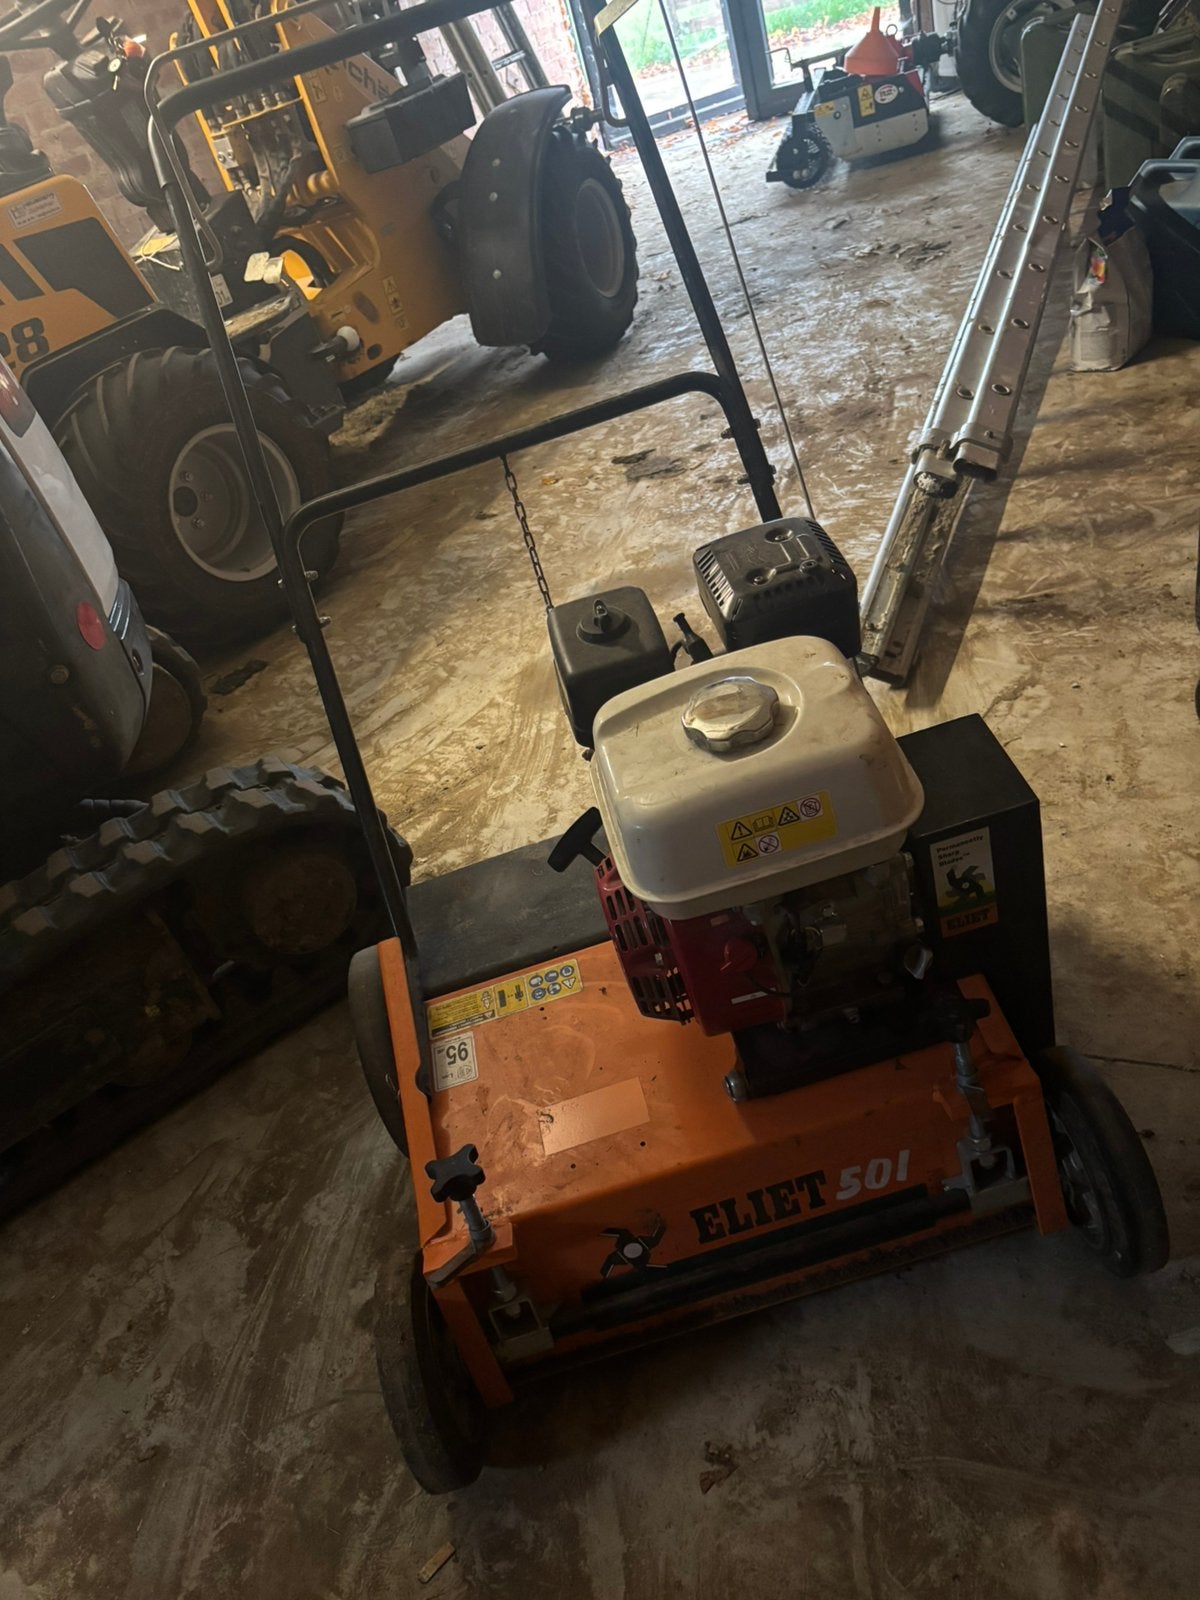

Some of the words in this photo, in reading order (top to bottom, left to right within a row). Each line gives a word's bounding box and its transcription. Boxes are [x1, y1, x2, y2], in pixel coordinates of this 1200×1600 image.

[936, 835, 984, 854] Permanently
[937, 849, 960, 860] Sharp
[946, 908, 989, 929] ELIET
[446, 1041, 469, 1066] 95
[689, 1169, 826, 1244] ELIET
[836, 1149, 911, 1201] 501
